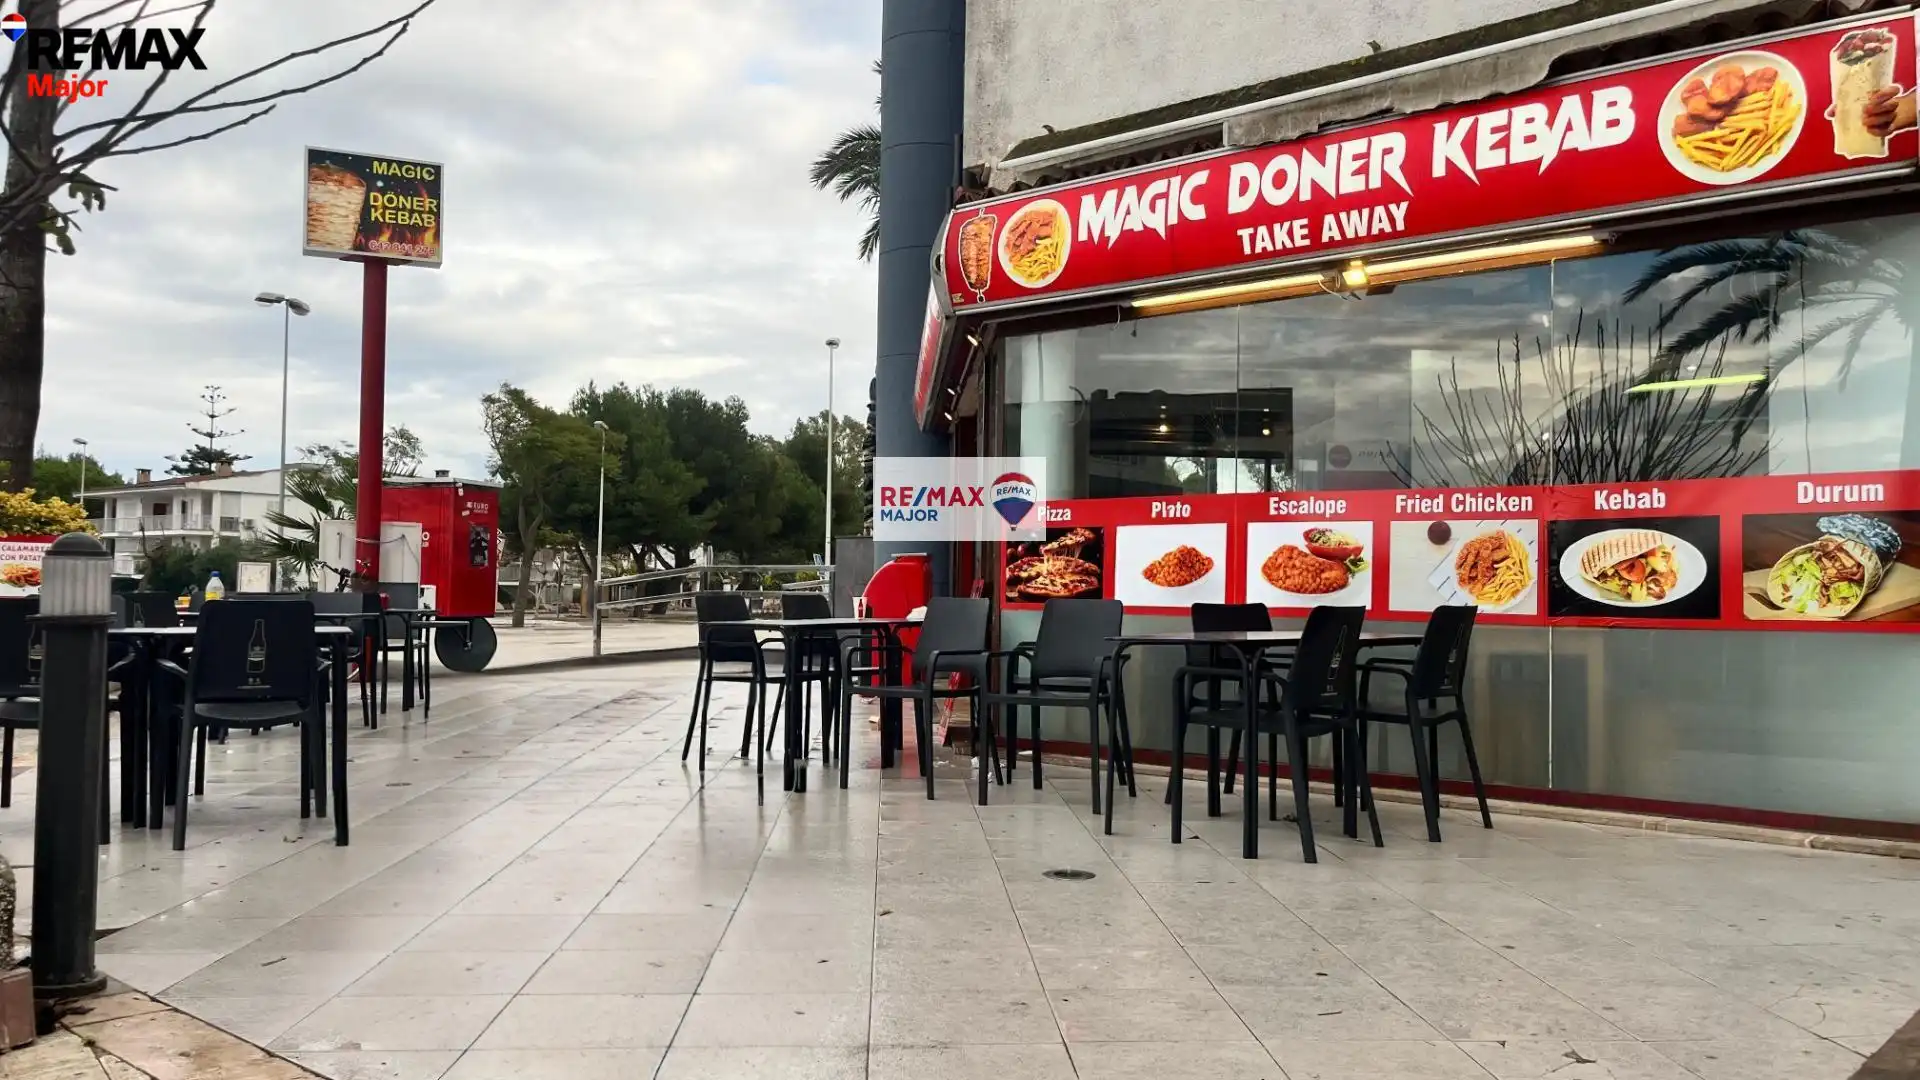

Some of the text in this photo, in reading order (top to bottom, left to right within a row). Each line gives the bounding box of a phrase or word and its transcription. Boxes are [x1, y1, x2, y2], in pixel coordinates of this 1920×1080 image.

[372, 160, 435, 181] MAGIC
[1078, 85, 1636, 250] MAGIC DONER KEBAB
[369, 191, 438, 212] DÖNER
[371, 208, 435, 227] KEBAB
[1237, 201, 1410, 255] TAKE AWAY
[1395, 492, 1533, 513] Fried Chicken
[1594, 487, 1666, 510] Kebab
[1797, 481, 1884, 504] Durum
[1037, 505, 1072, 522] Pizza
[1151, 501, 1191, 519] Plato
[1269, 496, 1347, 516] Escalope
